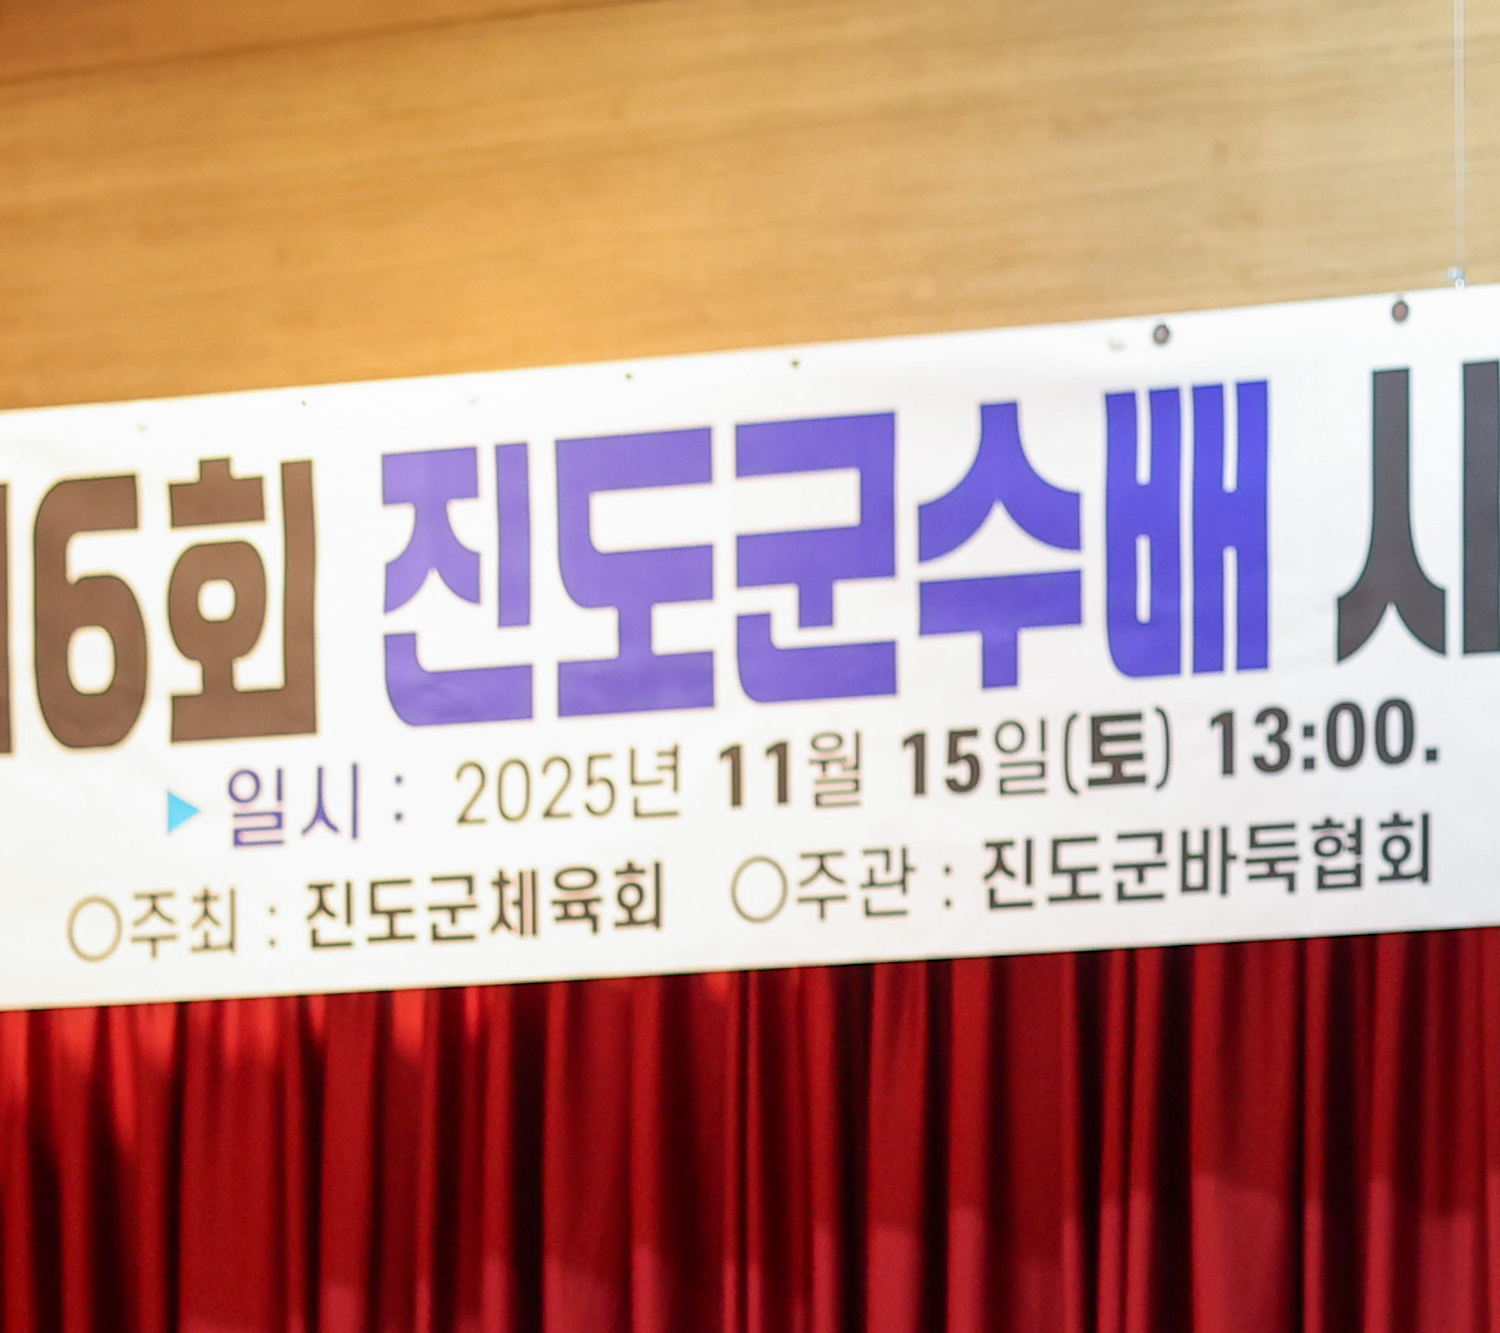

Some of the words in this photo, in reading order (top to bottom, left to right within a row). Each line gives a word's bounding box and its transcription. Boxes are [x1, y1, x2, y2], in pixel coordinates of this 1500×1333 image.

[381, 378, 1270, 727] 진도군수배
[227, 763, 358, 848] 일시
[455, 743, 680, 826] 2025년
[719, 730, 862, 810] 11월
[901, 706, 1171, 797] 15일(토)
[1209, 696, 1439, 777] 13:00.
[306, 859, 663, 951] 진도군체육회
[982, 812, 1431, 912] 진도군바둑협회
